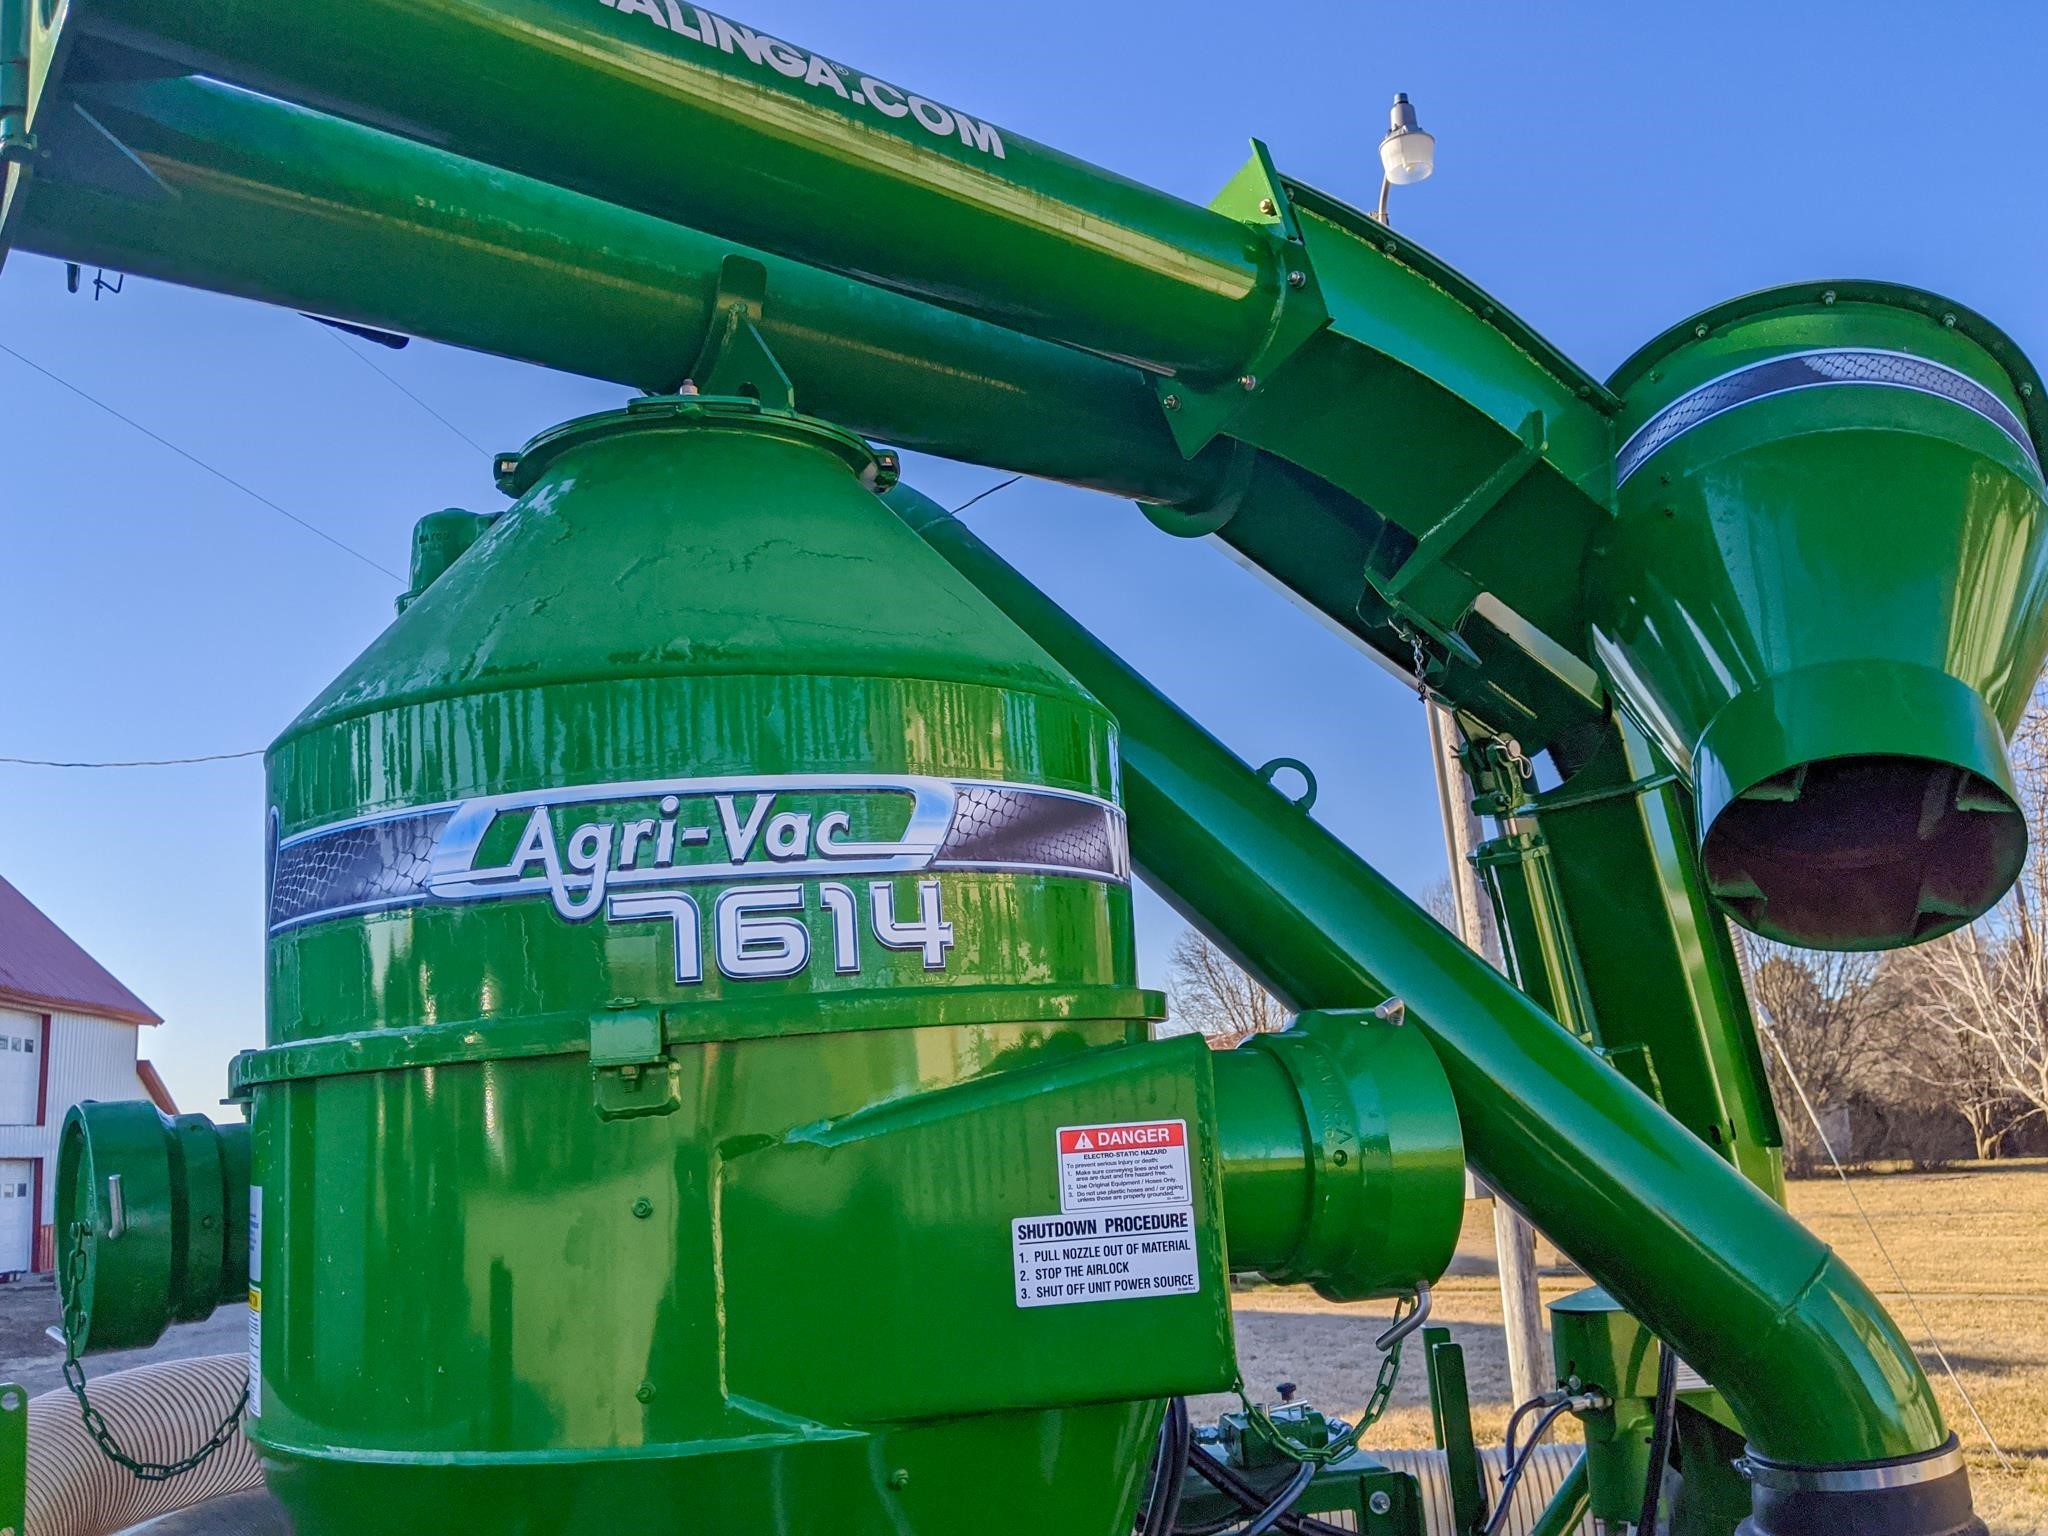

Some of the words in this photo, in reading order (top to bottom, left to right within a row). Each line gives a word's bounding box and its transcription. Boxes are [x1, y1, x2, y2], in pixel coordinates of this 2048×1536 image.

[600, 0, 1005, 159] ALINGA.COM
[503, 792, 858, 920] Agri-Vac
[607, 880, 954, 984] 7614
[1098, 1128, 1170, 1146] DANGER
[1083, 1150, 1139, 1160] ELECTRO-STATIC
[1140, 1148, 1167, 1156] HAZARD
[1105, 1167, 1133, 1175] conveying
[1088, 1181, 1110, 1189] Original
[1111, 1179, 1140, 1187] Equipment
[1107, 1187, 1126, 1195] plastic
[1166, 1183, 1184, 1192] piping
[1123, 1192, 1146, 1200] properly
[1018, 1219, 1097, 1240] SHUTDOWN
[1105, 1212, 1188, 1233] PROCEDURE
[1019, 1252, 1029, 1264] 1.
[1034, 1249, 1061, 1263] PULL
[1062, 1246, 1101, 1260] NOZZLE
[1103, 1244, 1124, 1257] OUT
[1126, 1243, 1140, 1255] OF
[1141, 1239, 1191, 1254] MATERIAL
[1020, 1270, 1030, 1282] 2.
[1035, 1267, 1063, 1280] STOP
[1064, 1265, 1084, 1278] THE
[1086, 1261, 1130, 1276] AIRLOCK
[1021, 1288, 1031, 1300] 3.
[1036, 1284, 1066, 1299] SHUT
[1067, 1282, 1087, 1296] OFF
[1088, 1281, 1112, 1294] UNIT
[1114, 1276, 1152, 1292] POWER
[1153, 1274, 1195, 1289] SOURCE
